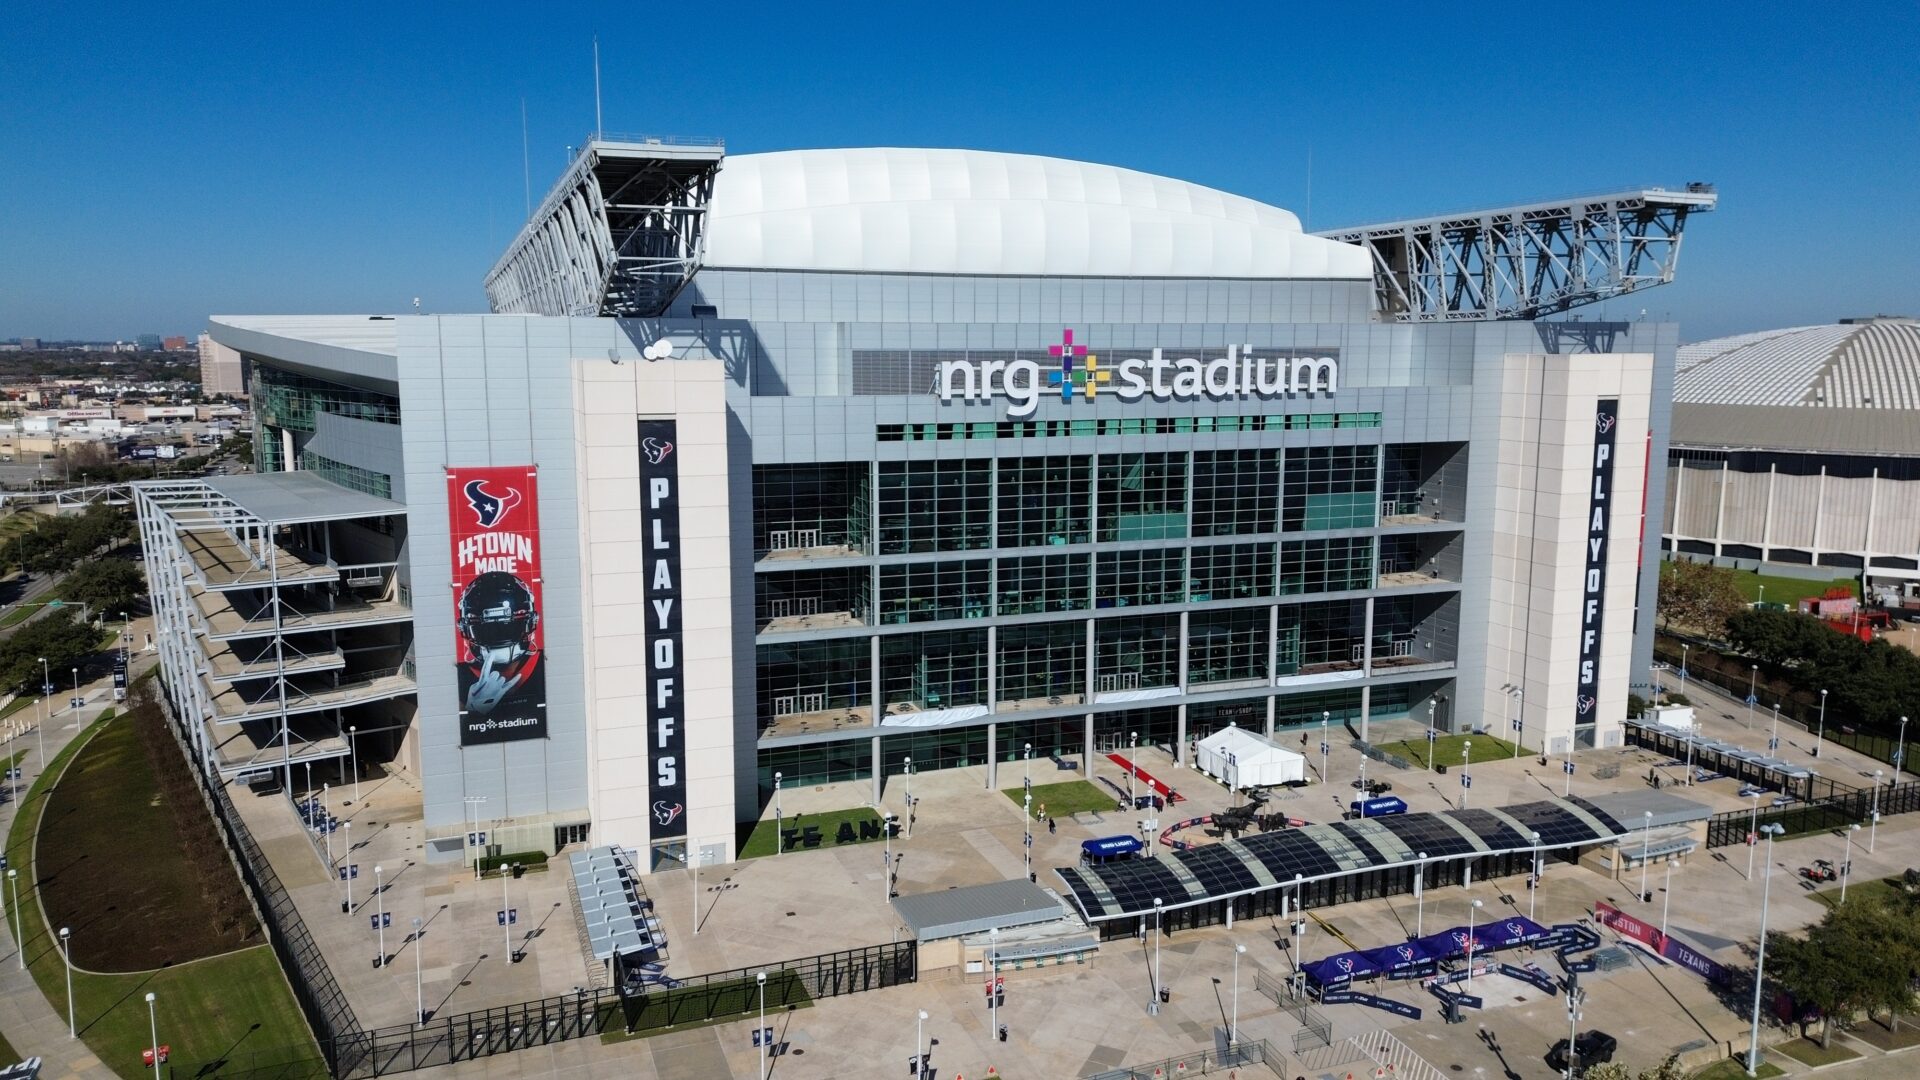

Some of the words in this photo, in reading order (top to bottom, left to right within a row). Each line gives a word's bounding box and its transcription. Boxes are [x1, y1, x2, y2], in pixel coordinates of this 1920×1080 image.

[940, 357, 1040, 417] nrg
[1116, 343, 1339, 398] stadium
[474, 556, 517, 575] MADE
[1581, 443, 1610, 685] PLAYOFFS
[649, 477, 678, 787] PLAYOFFS
[469, 722, 486, 732] nrg
[498, 717, 538, 728] stadium
[1603, 909, 1641, 936] HOUSTON
[1678, 948, 1711, 975] TEXANS
